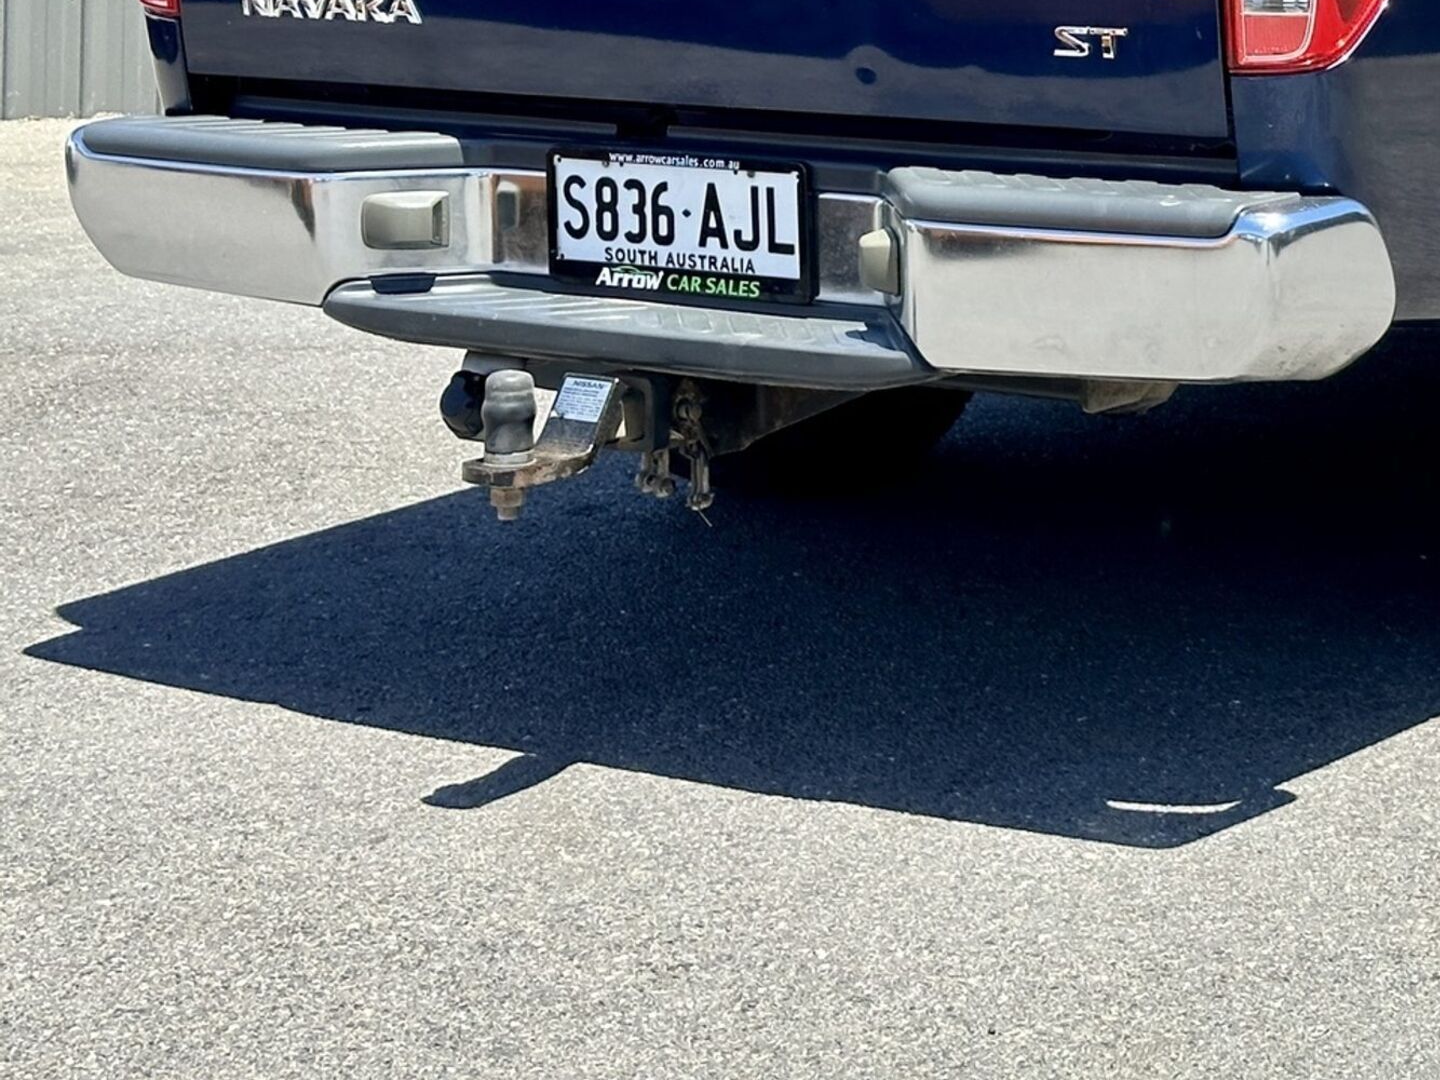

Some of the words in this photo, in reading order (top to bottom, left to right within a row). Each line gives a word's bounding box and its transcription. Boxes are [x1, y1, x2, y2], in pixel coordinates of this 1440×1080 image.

[1053, 26, 1128, 59] ST
[608, 152, 740, 170] www.arrowcarsales.com.au
[604, 246, 659, 266] SOUTH
[665, 252, 756, 274] AUSTRALIA
[595, 266, 664, 291] Arrow
[667, 274, 701, 293] CAR
[705, 277, 761, 299] SALES
